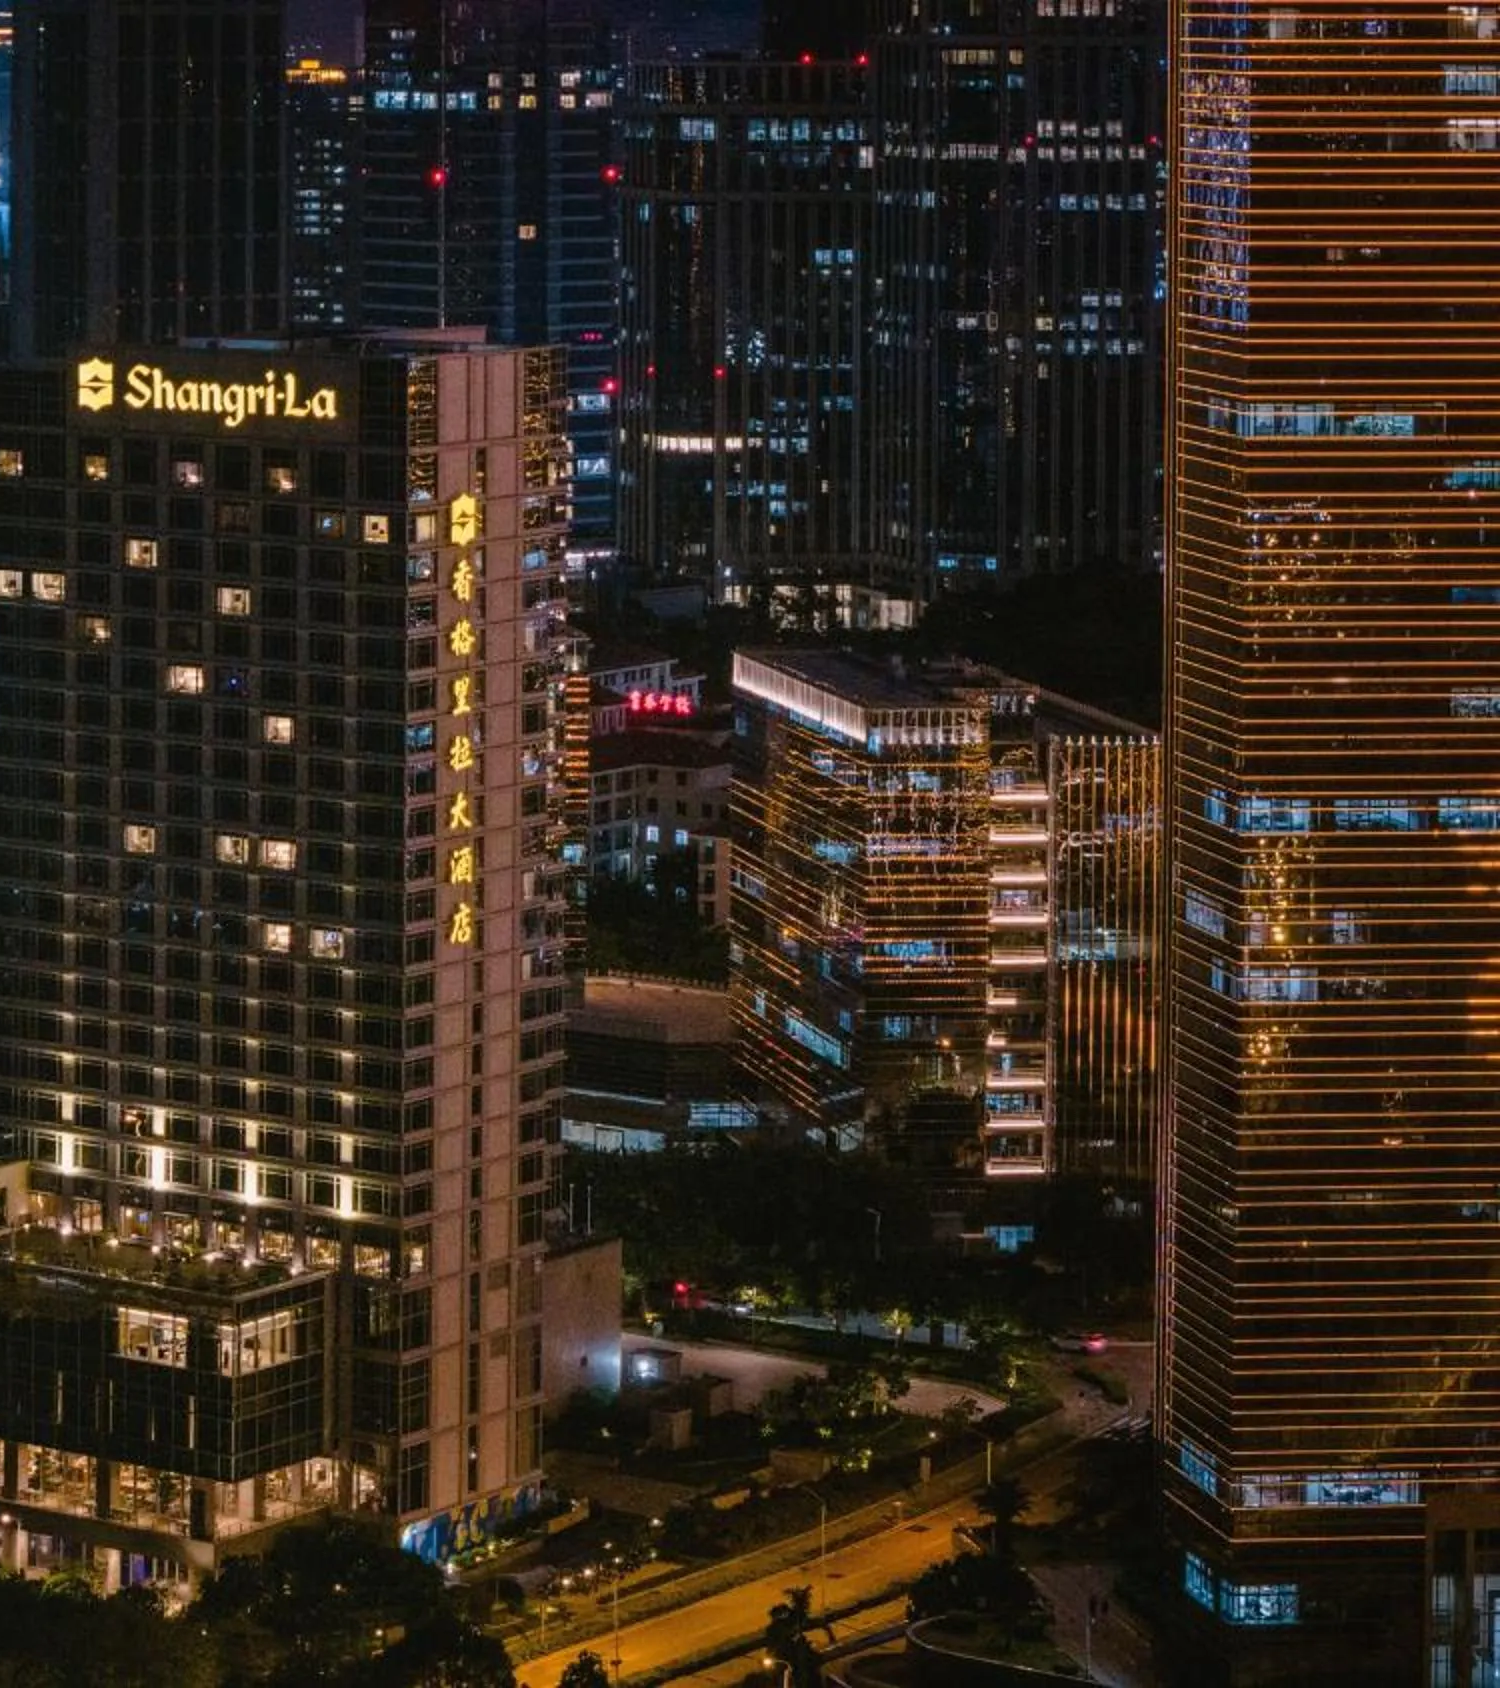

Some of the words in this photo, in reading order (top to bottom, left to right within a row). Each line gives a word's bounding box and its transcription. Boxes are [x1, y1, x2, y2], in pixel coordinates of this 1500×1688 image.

[124, 363, 337, 427] Shangri-La
[450, 559, 476, 944] 香格里拉大酒店
